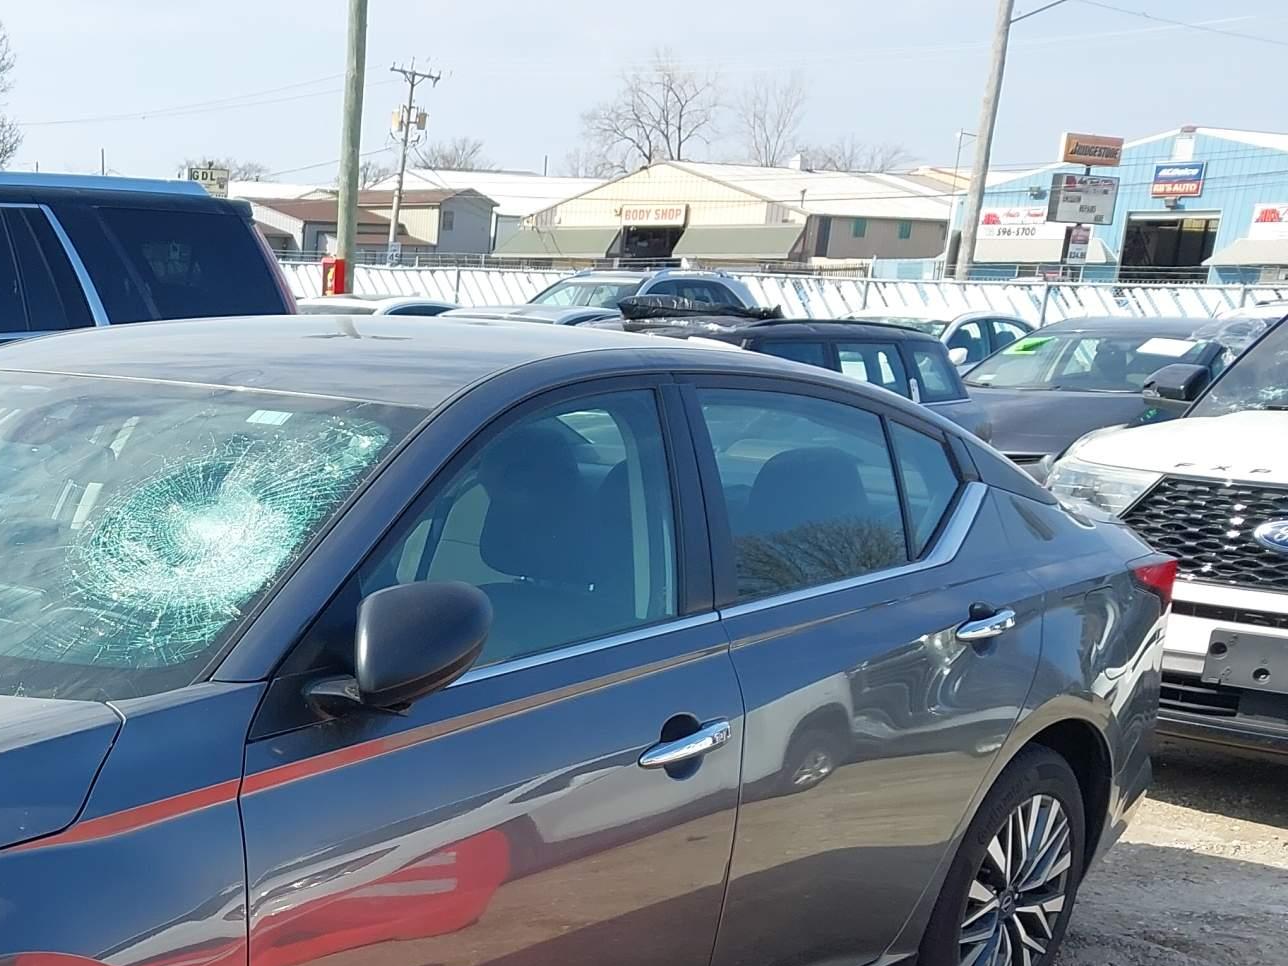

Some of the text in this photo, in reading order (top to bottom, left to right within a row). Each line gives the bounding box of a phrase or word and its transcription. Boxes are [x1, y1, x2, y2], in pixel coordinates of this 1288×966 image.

[192, 170, 215, 181] GDL
[1174, 183, 1198, 193] AUTO
[624, 207, 682, 221] BODY SHOP
[996, 227, 1037, 237] 596-5700
